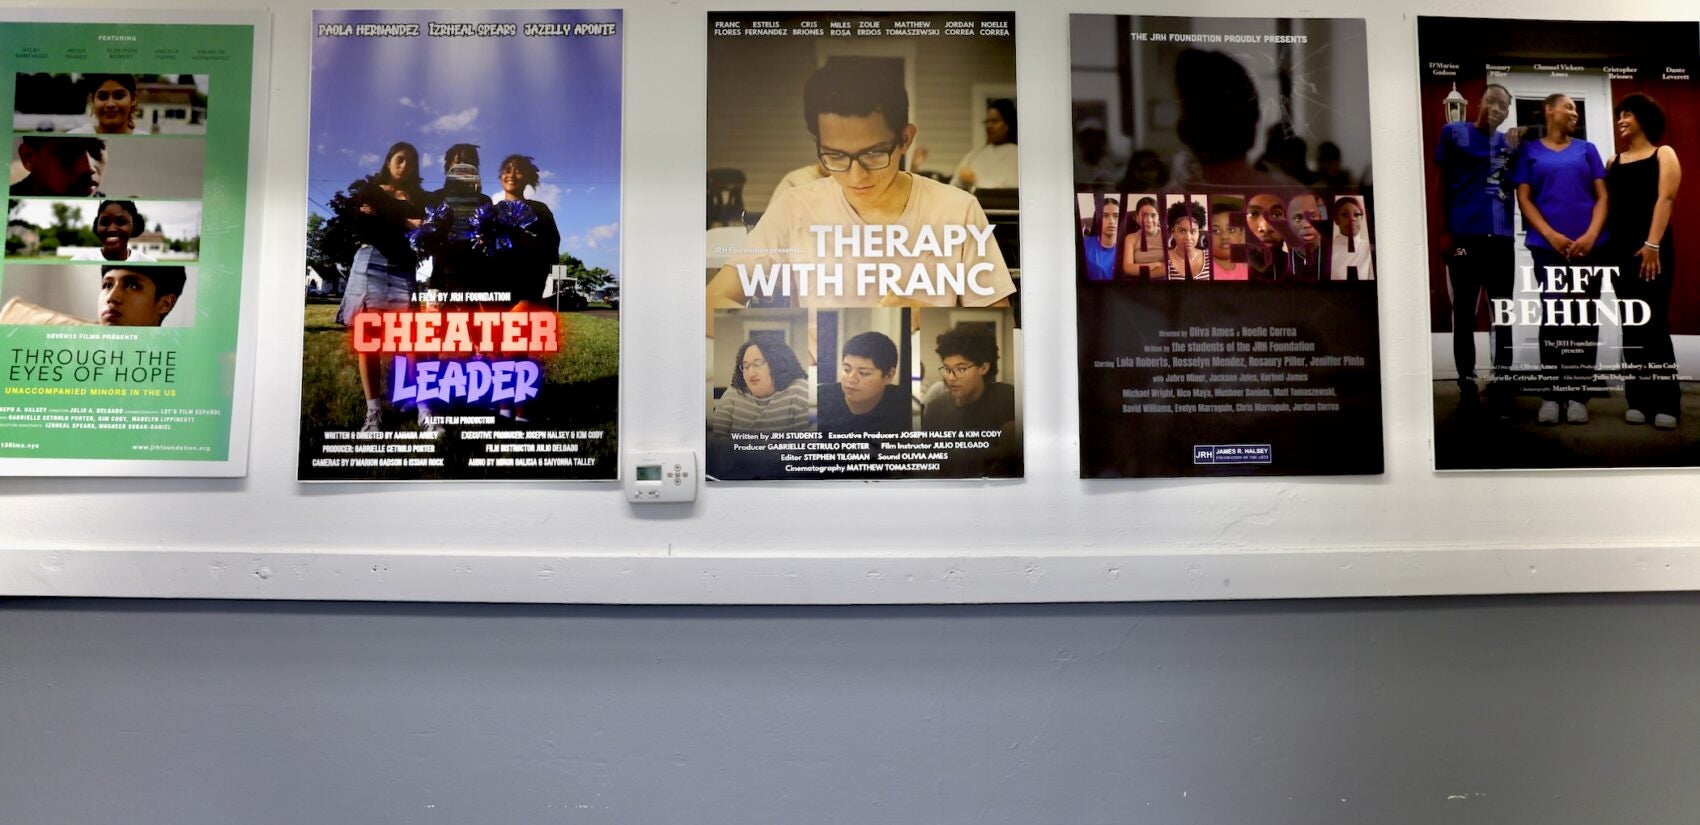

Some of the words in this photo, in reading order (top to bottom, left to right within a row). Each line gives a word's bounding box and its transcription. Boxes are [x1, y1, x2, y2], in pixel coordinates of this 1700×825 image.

[318, 24, 354, 37] PAOLA
[356, 24, 420, 37] HERNANDEZ
[477, 24, 517, 37] SPEARS
[524, 24, 570, 36] JAZELLY
[573, 23, 617, 37] APONTE
[1130, 32, 1148, 41] THE
[1150, 33, 1166, 42] JRH
[1169, 34, 1222, 42] FOUNDATION
[1224, 34, 1261, 43] PROUDLY
[1264, 35, 1308, 44] PRESENTS
[1429, 62, 1460, 70] D'Marion
[1486, 64, 1512, 72] Rosaury
[1560, 64, 1584, 72] Vickers
[1602, 66, 1638, 74] Cristopher
[808, 224, 997, 257] THERAPY
[736, 263, 844, 296] WITH
[857, 262, 995, 297] FRANC
[1520, 266, 1620, 294] LEFT
[411, 292, 417, 302] A
[418, 292, 437, 302] FILM
[438, 292, 448, 302] BY
[450, 292, 464, 302] JRH
[465, 292, 511, 302] FOUNDATION
[1490, 298, 1652, 326] BEHIND
[353, 312, 558, 352] CHEATER
[1189, 326, 1210, 337] Oliva
[1212, 326, 1234, 337] Ames
[1242, 326, 1268, 337] Noelle
[1269, 327, 1297, 337] Correa
[1172, 342, 1186, 352] the
[1187, 342, 1224, 352] students
[1226, 342, 1235, 352] of
[1236, 342, 1250, 352] the
[1252, 342, 1268, 352] JRH
[1269, 342, 1315, 352] Foundation
[11, 349, 124, 366] THROUGH
[135, 351, 177, 367] THE
[1116, 356, 1135, 368] Lola
[1136, 356, 1170, 368] Roberts,
[1172, 356, 1210, 369] Rosselyn
[1212, 356, 1247, 368] Mendez,
[1248, 356, 1282, 368] Rosaury
[1344, 356, 1364, 366] Pinto
[1622, 362, 1642, 372] Halsey
[1648, 362, 1662, 370] Kim
[9, 366, 63, 382] EYES
[74, 367, 104, 382] OF
[115, 367, 176, 383] HOPE
[391, 355, 539, 404] LEADER
[1610, 374, 1636, 382] Delgado
[5, 388, 87, 396] UNACCOMPANIED
[143, 389, 161, 397] THE
[1122, 388, 1150, 398] Michael
[1273, 388, 1289, 397] Matt
[1122, 404, 1142, 412] David
[1174, 404, 1197, 414] Evelyn
[445, 416, 459, 425] FILM
[460, 416, 496, 425] PRODUCTION
[324, 432, 350, 440] WRITTEN
[356, 432, 384, 440] DIRECTED
[384, 432, 394, 440] BY
[461, 431, 492, 440] EXECUTIVE
[547, 430, 570, 439] HALSEY
[731, 432, 758, 440] Written
[760, 432, 770, 442] by
[828, 432, 862, 440] Executive
[863, 431, 899, 440] Producers
[965, 430, 980, 438] KIM
[354, 444, 386, 453] GABRIELLE
[486, 444, 499, 452] FILM
[500, 444, 535, 452] INSTRUCTOR
[552, 444, 578, 452] DELGADO
[836, 453, 870, 461] TILGMAN
[878, 452, 900, 460] Sound
[1196, 450, 1212, 459] JRH
[312, 458, 340, 467] CAMERAS
[341, 458, 350, 467] BY
[573, 458, 596, 467] TALLEY
[785, 464, 845, 473] Cinematography
[846, 464, 884, 472] MATTHEW
[884, 463, 940, 471] TOMASZEWSKI
